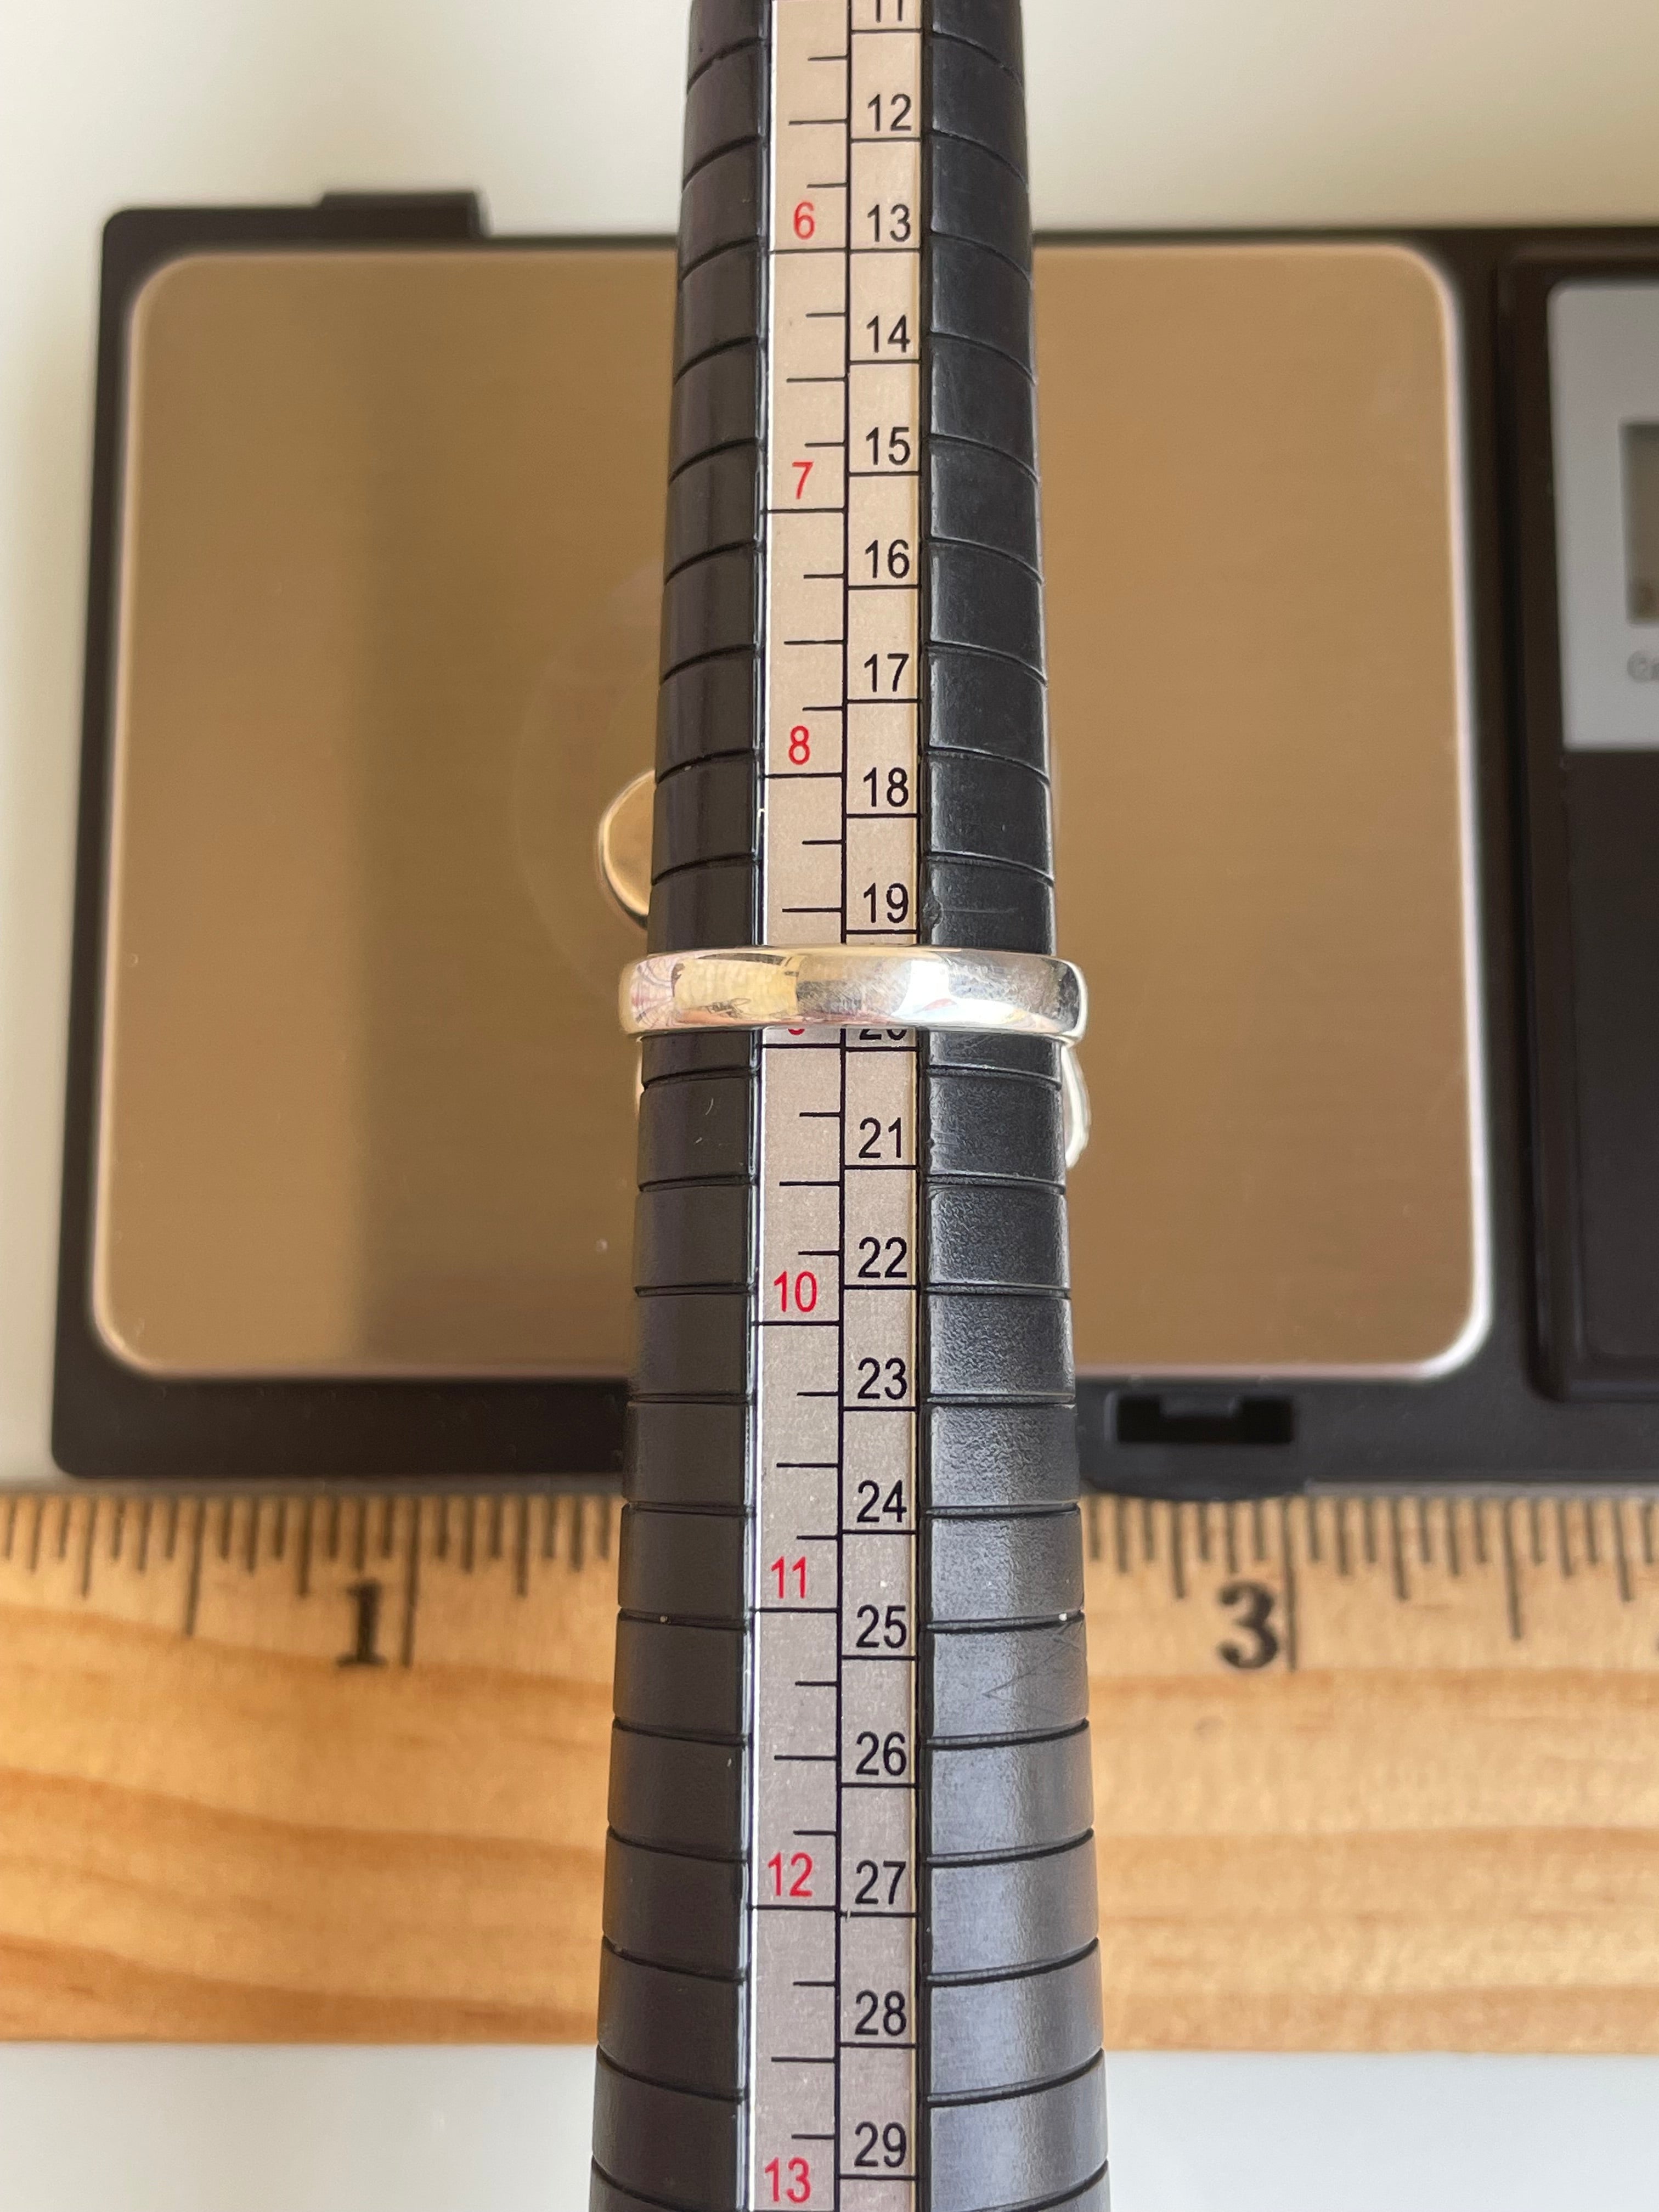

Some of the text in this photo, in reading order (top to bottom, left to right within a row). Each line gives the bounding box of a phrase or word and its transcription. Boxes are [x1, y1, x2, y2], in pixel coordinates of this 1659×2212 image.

[868, 93, 912, 132] 12
[793, 201, 816, 240] 6
[867, 204, 911, 242] 13
[867, 314, 911, 353] 14
[866, 426, 911, 466] 15
[792, 460, 814, 499] 7
[865, 539, 911, 579] 16
[864, 653, 910, 692] 17
[788, 725, 811, 766] 8
[863, 767, 910, 808] 18
[863, 882, 910, 924] 19
[858, 1117, 902, 1159] 21
[857, 1237, 908, 1279] 22
[774, 1270, 818, 1313] 10
[857, 1357, 908, 1401] 23
[856, 1480, 908, 1523] 24
[771, 1556, 806, 1599] 11
[336, 1578, 386, 1669] 1
[855, 1604, 908, 1649] 25
[1217, 1580, 1279, 1669] 3
[855, 1731, 908, 1776] 26
[768, 1852, 814, 1898] 12
[855, 1860, 907, 1905] 27
[854, 1989, 908, 2037] 28
[854, 2121, 908, 2168] 29
[765, 2157, 812, 2204] 13
